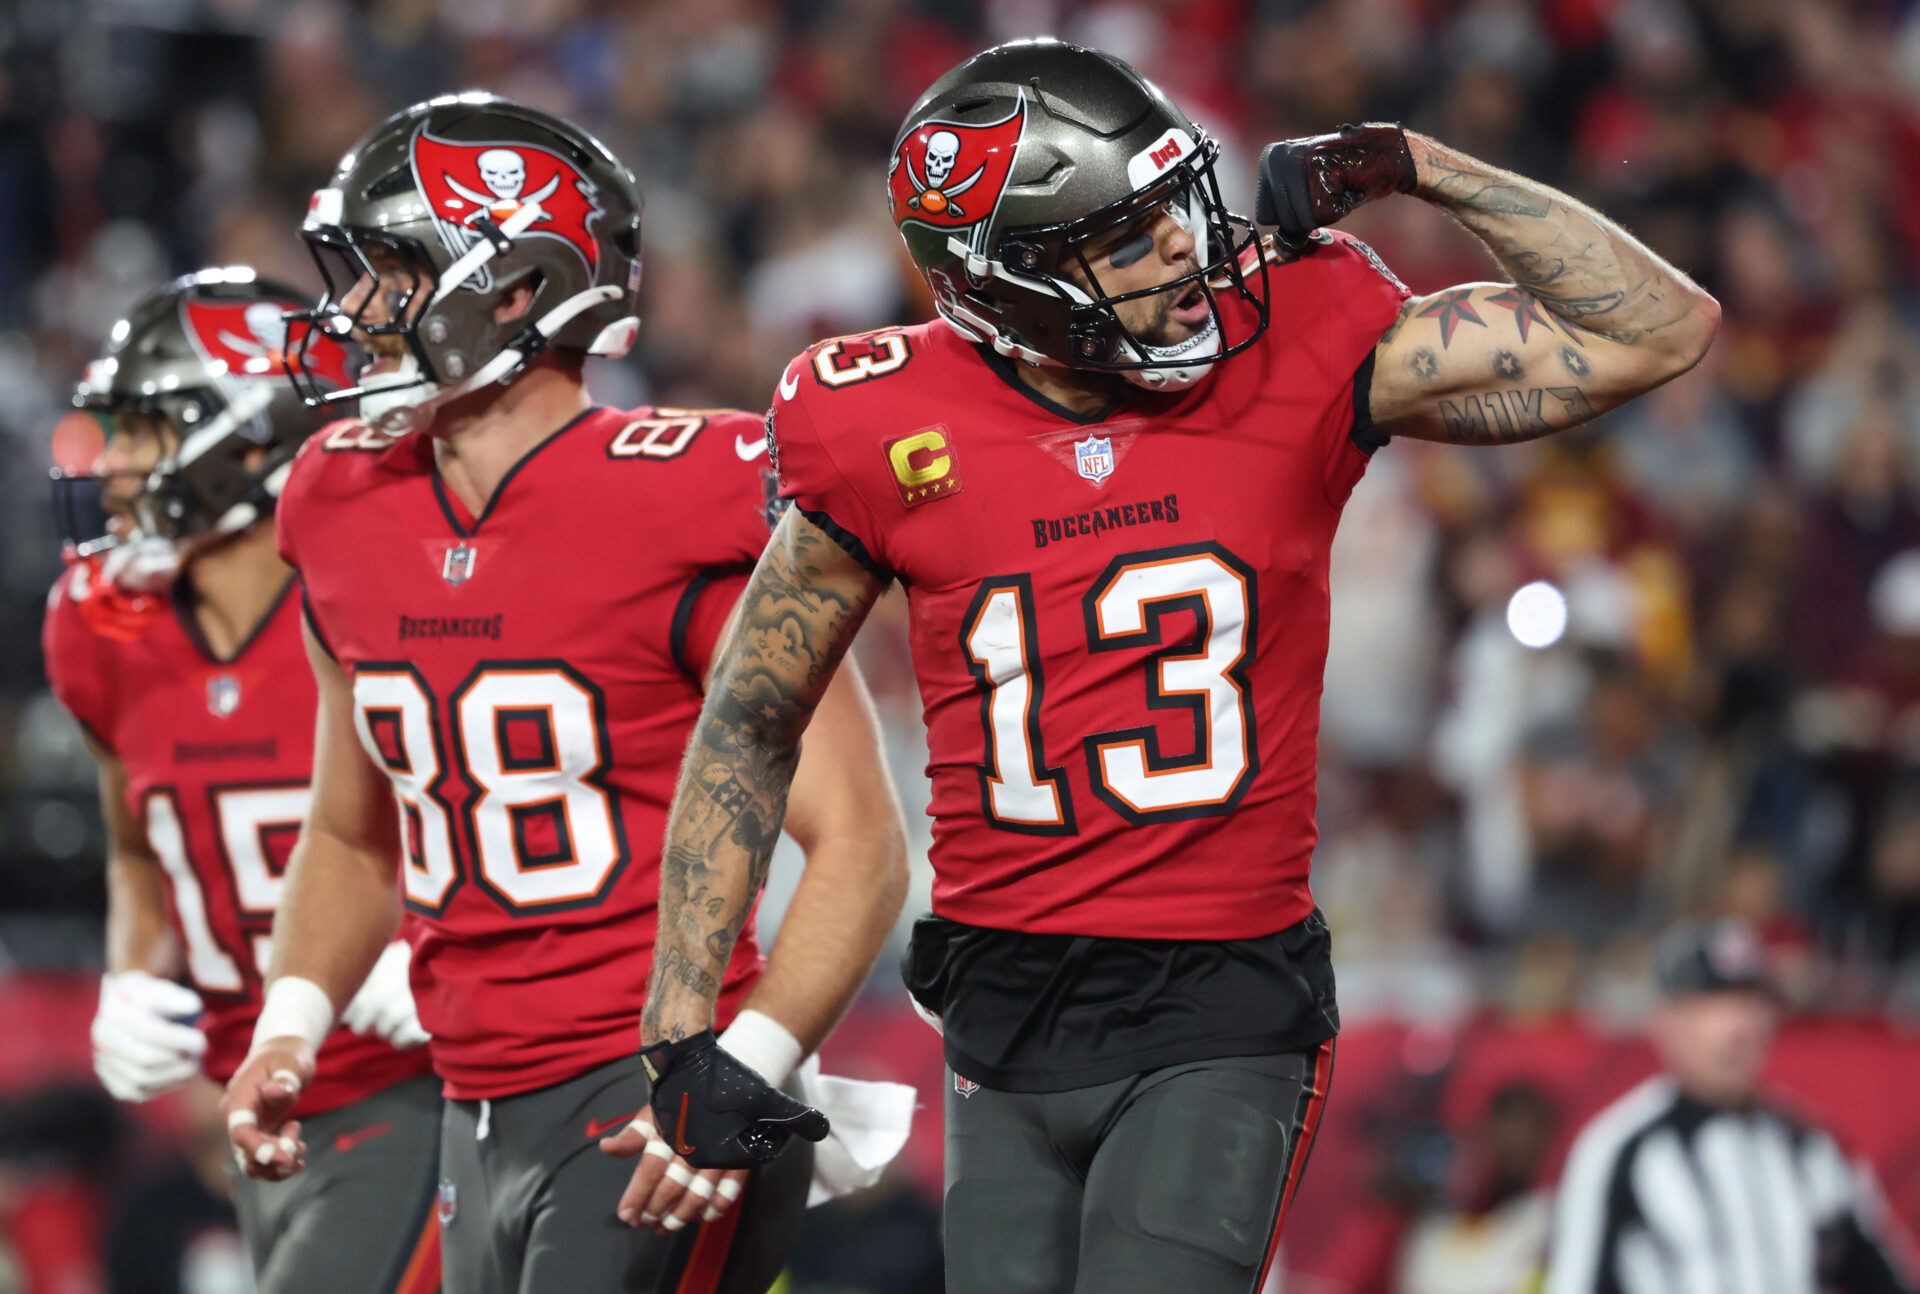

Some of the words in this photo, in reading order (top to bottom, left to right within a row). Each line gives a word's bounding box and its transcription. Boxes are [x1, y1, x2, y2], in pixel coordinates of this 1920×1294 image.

[811, 326, 912, 391] 3
[890, 431, 951, 487] C
[1083, 455, 1109, 474] NFL
[1032, 494, 1179, 548] BUCCANEERS
[958, 540, 1260, 836] 13
[353, 659, 631, 920] 88
